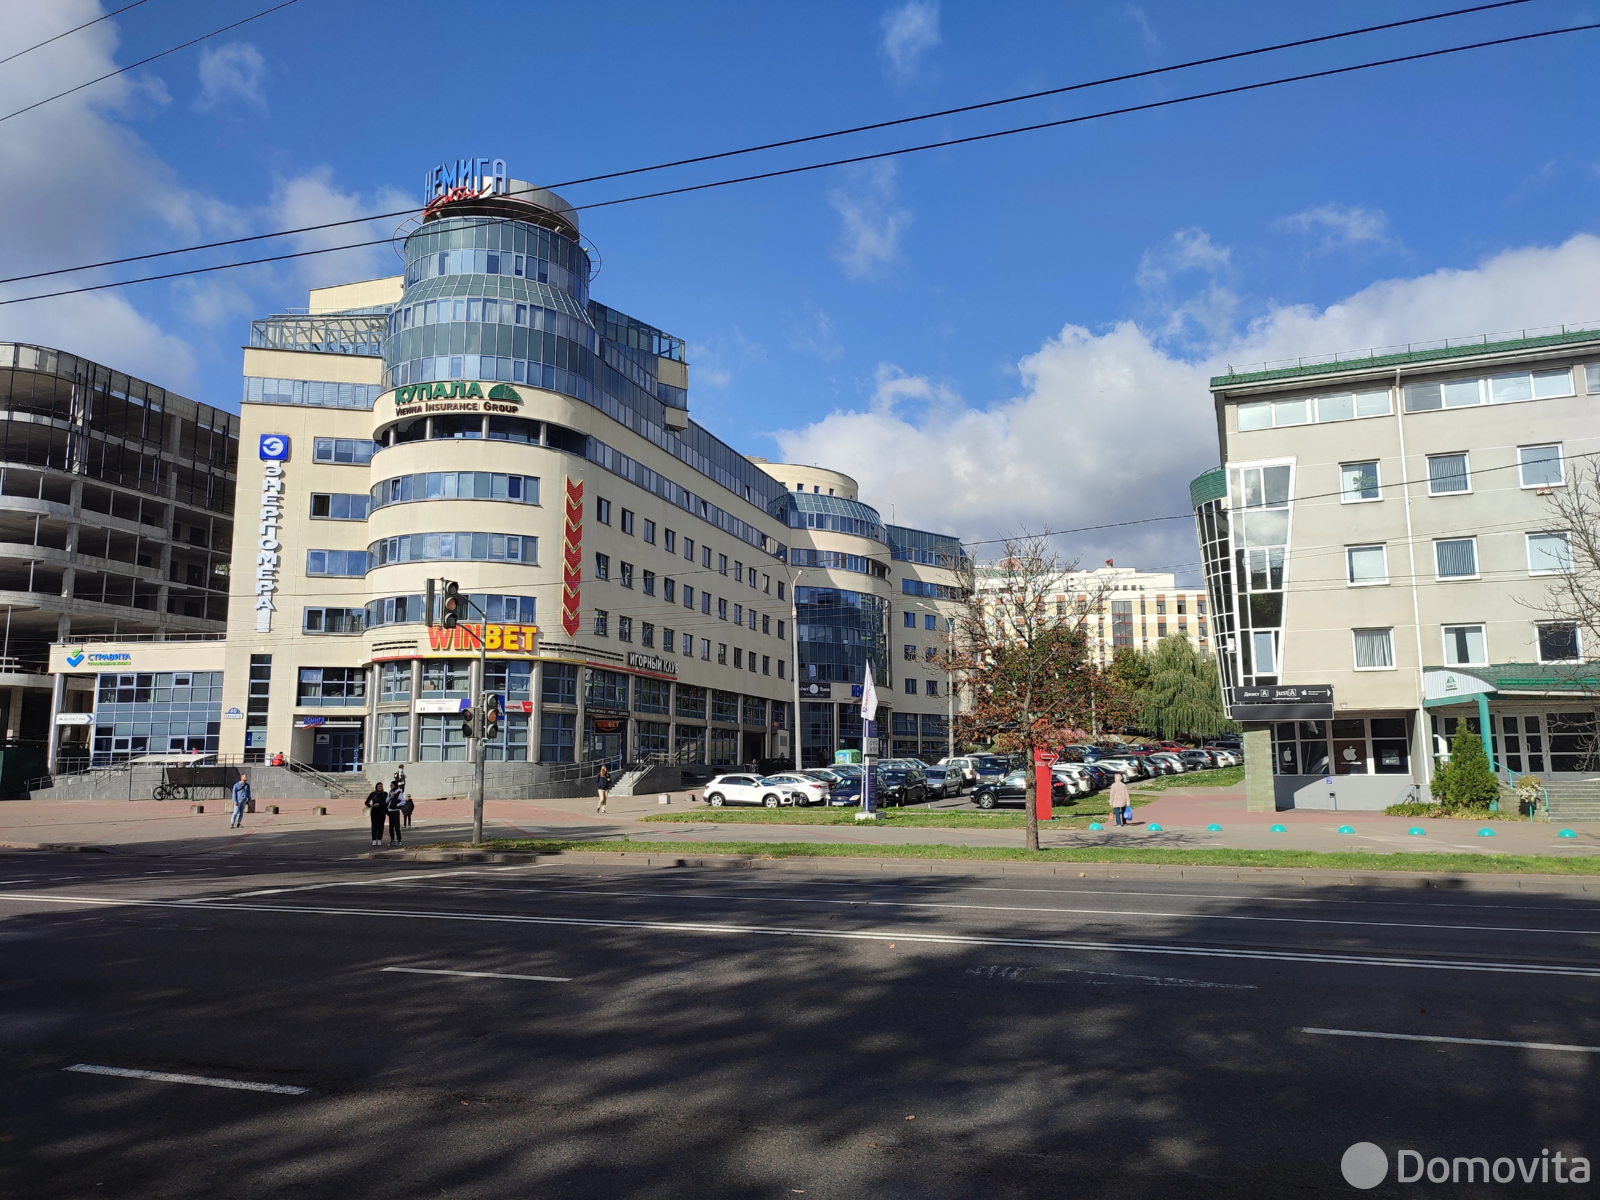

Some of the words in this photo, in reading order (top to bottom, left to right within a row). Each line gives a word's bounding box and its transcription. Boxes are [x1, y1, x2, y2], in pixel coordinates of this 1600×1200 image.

[424, 157, 506, 207] НЕМИГА
[394, 381, 483, 405] КУПАЛА
[256, 464, 282, 610] ЭНЕРГОМЕРА
[427, 623, 538, 651] WINBET
[87, 652, 132, 662] СТРАВИТА
[628, 652, 664, 672] ИГОРНЫЙ
[662, 661, 680, 674] КЛУБ
